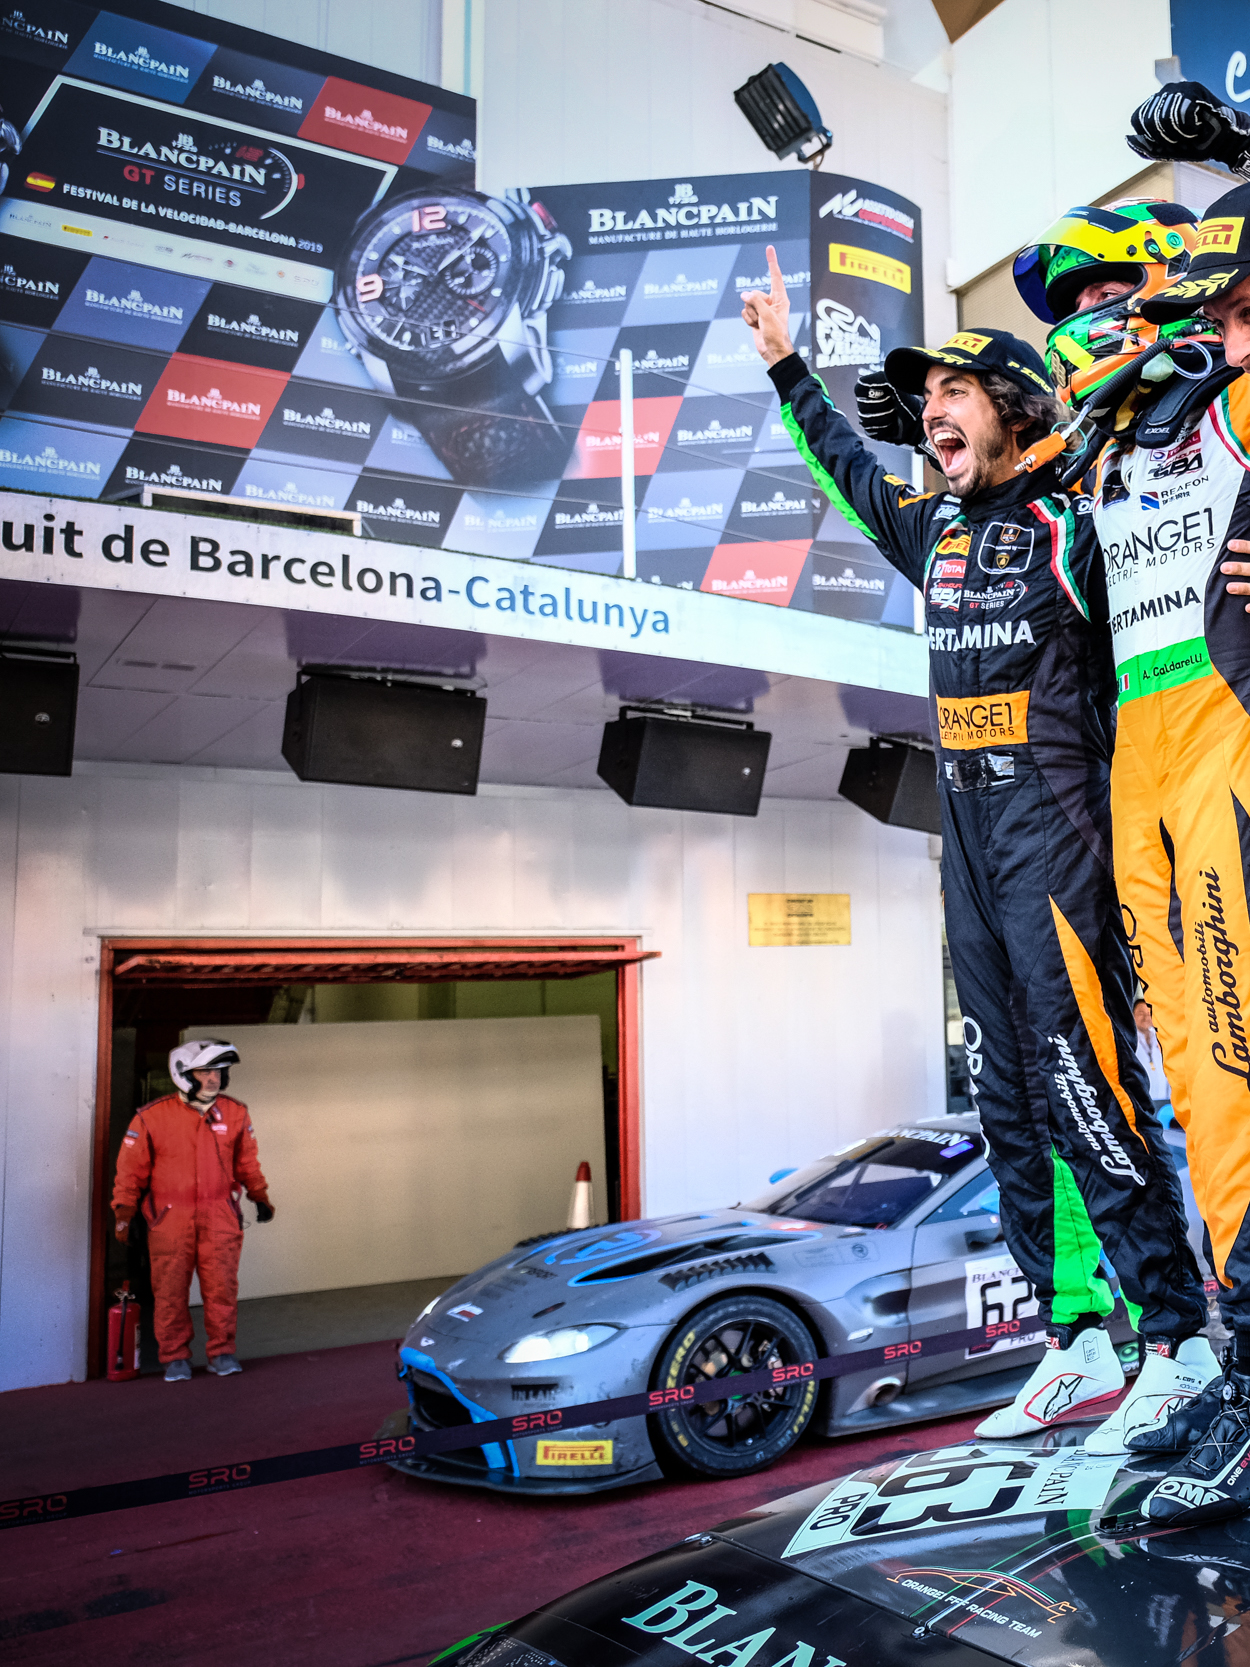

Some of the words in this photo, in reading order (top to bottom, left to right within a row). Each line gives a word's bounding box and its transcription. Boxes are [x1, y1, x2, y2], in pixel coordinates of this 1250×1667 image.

[94, 41, 189, 79] BLANCPAIN
[213, 75, 303, 110] BLANCPAIN
[325, 105, 409, 139] BLANCPAIN
[97, 127, 267, 187] BLANCPAIN
[123, 164, 154, 186] GT
[163, 175, 242, 208] SERIES
[62, 183, 120, 209] FESTIVAL
[122, 198, 138, 212] DE
[140, 201, 156, 216] LA
[297, 238, 324, 254] 2019
[588, 195, 779, 233] BLANCPAIN
[840, 252, 904, 285] PIRELLI
[644, 279, 718, 297] BLANCPAIN
[86, 289, 183, 320] BLANCPAIN
[206, 313, 299, 343] BLANCPAIN
[42, 367, 142, 396] BLANCPAIN
[167, 388, 261, 418] BLANCPAIN
[283, 407, 371, 436] BLANCPAIN
[677, 425, 753, 445] BLANCPAIN
[126, 466, 222, 492] BLANCPAIN
[1161, 475, 1209, 498] REAFON
[245, 484, 335, 509] BLANCPAIN
[356, 499, 440, 524] BLANCPAIN
[648, 502, 723, 519] BLANCPAIN
[1146, 538, 1215, 568] MOTORS
[101, 524, 171, 568] de
[190, 535, 670, 638] Barcelona-Catalunya
[712, 575, 787, 594] BLANCPAIN
[963, 587, 1015, 600] BLANCPAIN
[980, 601, 1005, 610] SERIES
[1153, 653, 1203, 677] Caldarelli
[967, 726, 1015, 741] MOTORS
[1195, 920, 1220, 1034] automobili
[1047, 1033, 1147, 1187] Lamborghini
[985, 1319, 1021, 1338] SRO
[884, 1341, 922, 1360] SRO
[772, 1362, 815, 1382] SRO
[649, 1385, 695, 1406] SRO
[512, 1410, 563, 1432] SRO
[359, 1435, 416, 1459] SRO
[543, 1444, 606, 1462] PIRELLI
[188, 1464, 252, 1489] SRO
[0, 1495, 67, 1520] SRO
[810, 1492, 858, 1531] PRO
[945, 1595, 969, 1608] FFF
[966, 1603, 1009, 1625] RACING
[1007, 1620, 1043, 1638] TEAM
